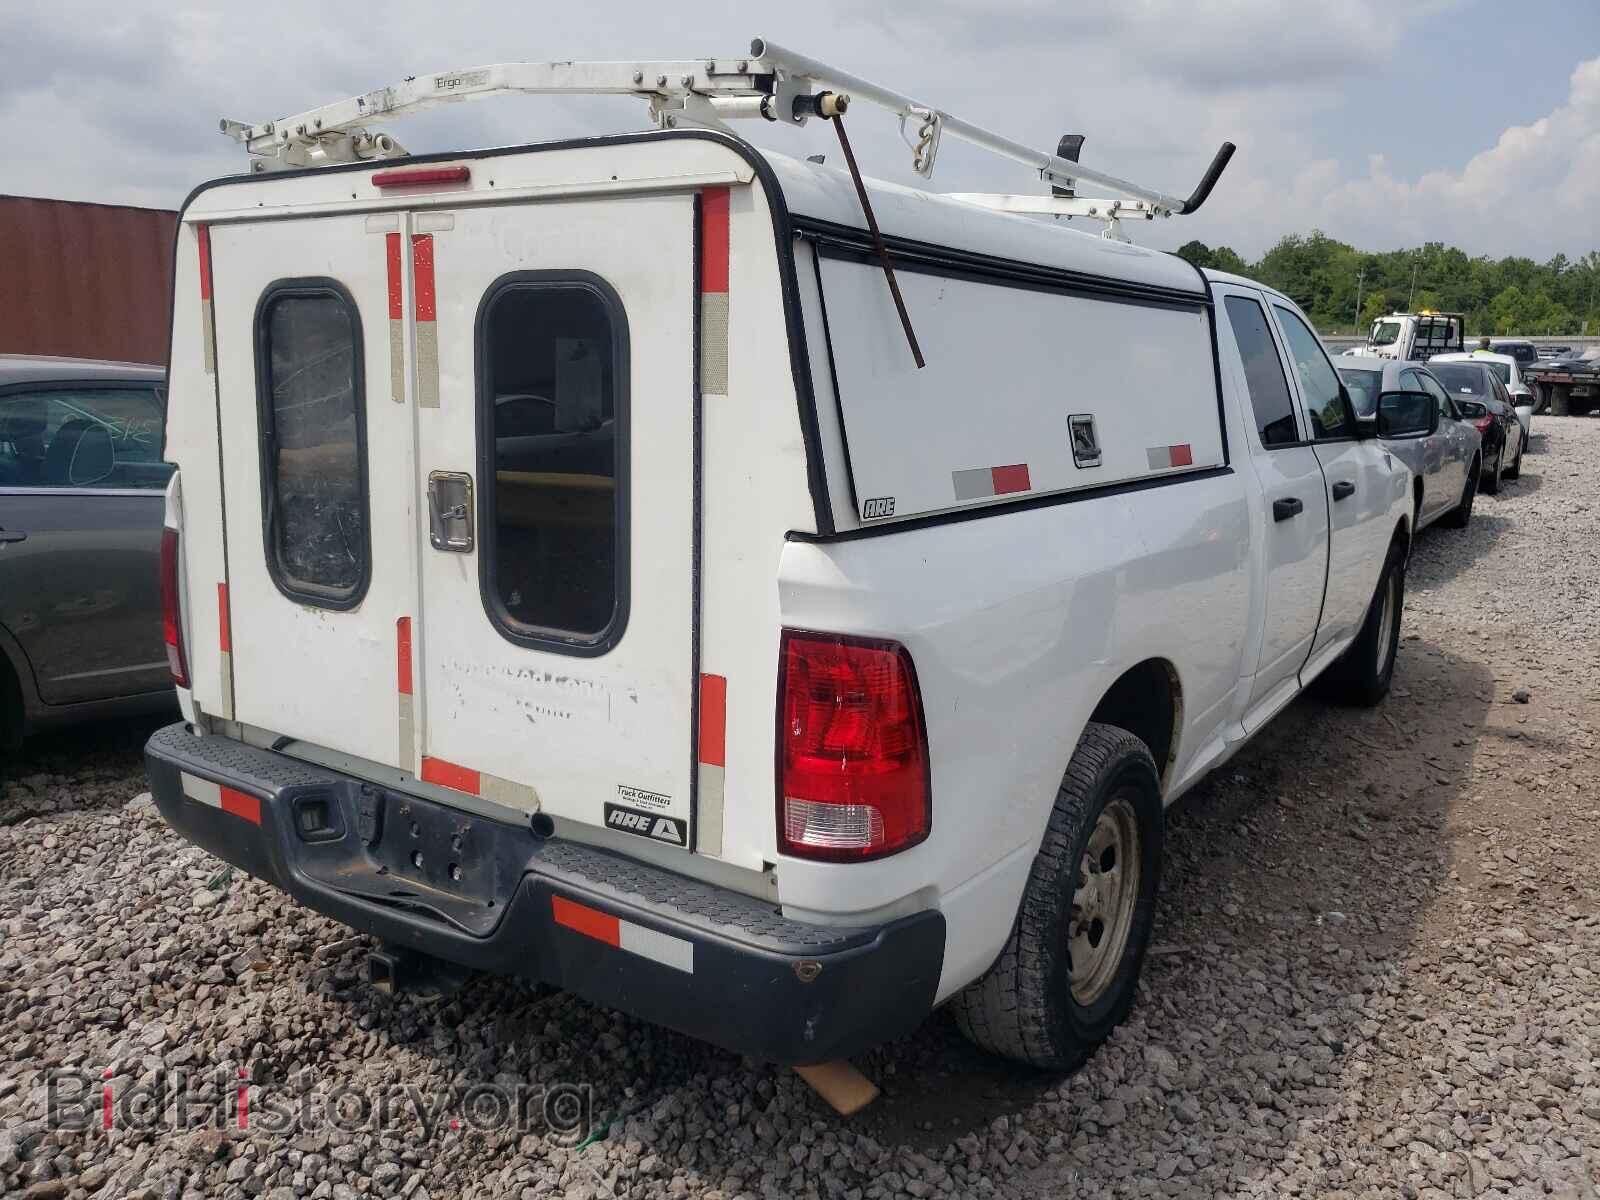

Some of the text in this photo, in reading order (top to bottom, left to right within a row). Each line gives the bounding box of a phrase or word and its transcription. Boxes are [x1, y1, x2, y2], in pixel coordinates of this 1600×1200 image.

[864, 496, 895, 519] ARE
[617, 785, 637, 798] Truck
[637, 792, 671, 806] Outfitters
[608, 809, 652, 832] ARE
